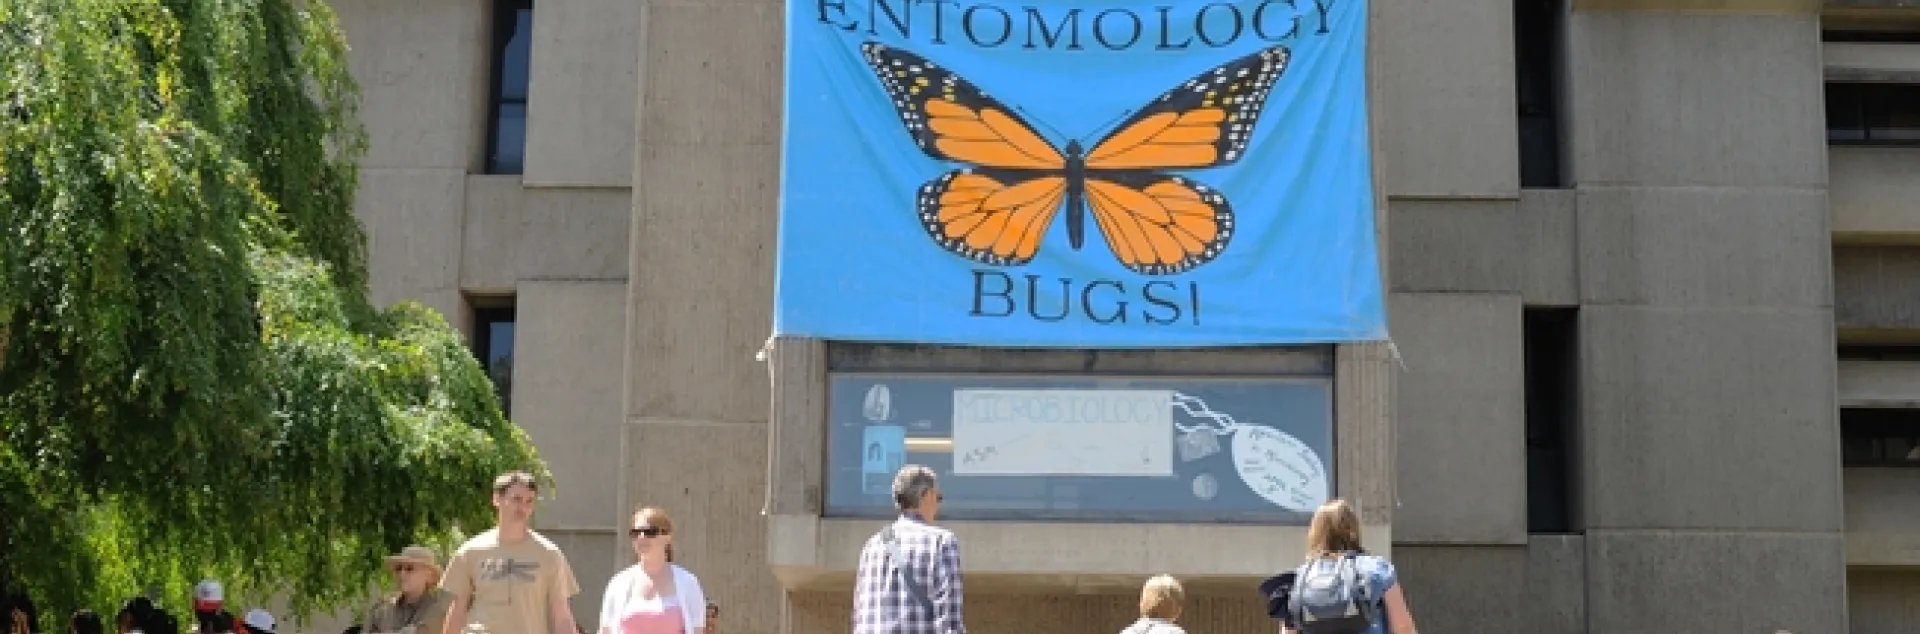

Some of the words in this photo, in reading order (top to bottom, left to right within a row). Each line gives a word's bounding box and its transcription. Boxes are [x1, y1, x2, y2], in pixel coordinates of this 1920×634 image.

[816, 0, 1337, 51] ENTOMOLOGY
[968, 269, 1201, 326] BUGS!
[957, 394, 1169, 425] MICROBIOLOGY
